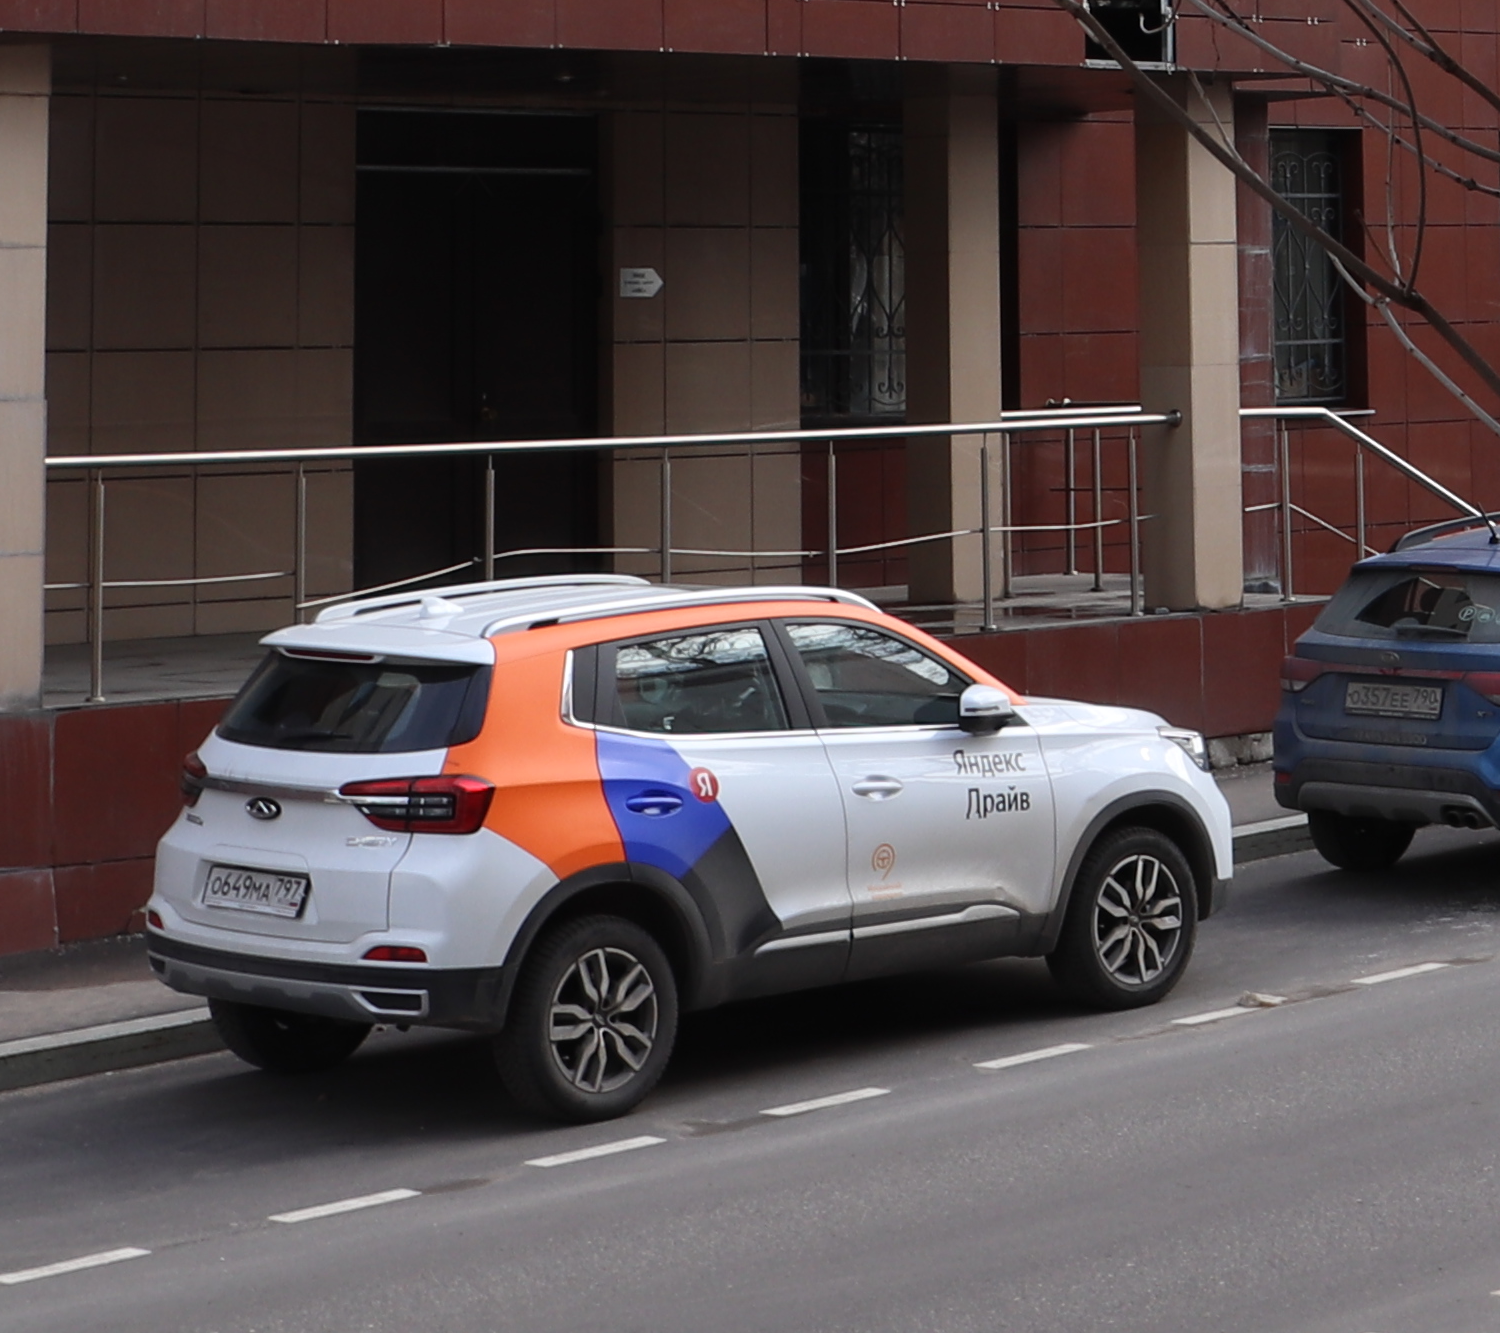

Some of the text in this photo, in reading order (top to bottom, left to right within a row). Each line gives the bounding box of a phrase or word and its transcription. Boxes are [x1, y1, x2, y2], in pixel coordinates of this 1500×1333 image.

[952, 749, 1027, 778] Яндекс
[696, 772, 714, 797] Я
[965, 785, 1031, 820] Драйв
[211, 873, 302, 902] О649МА 797
